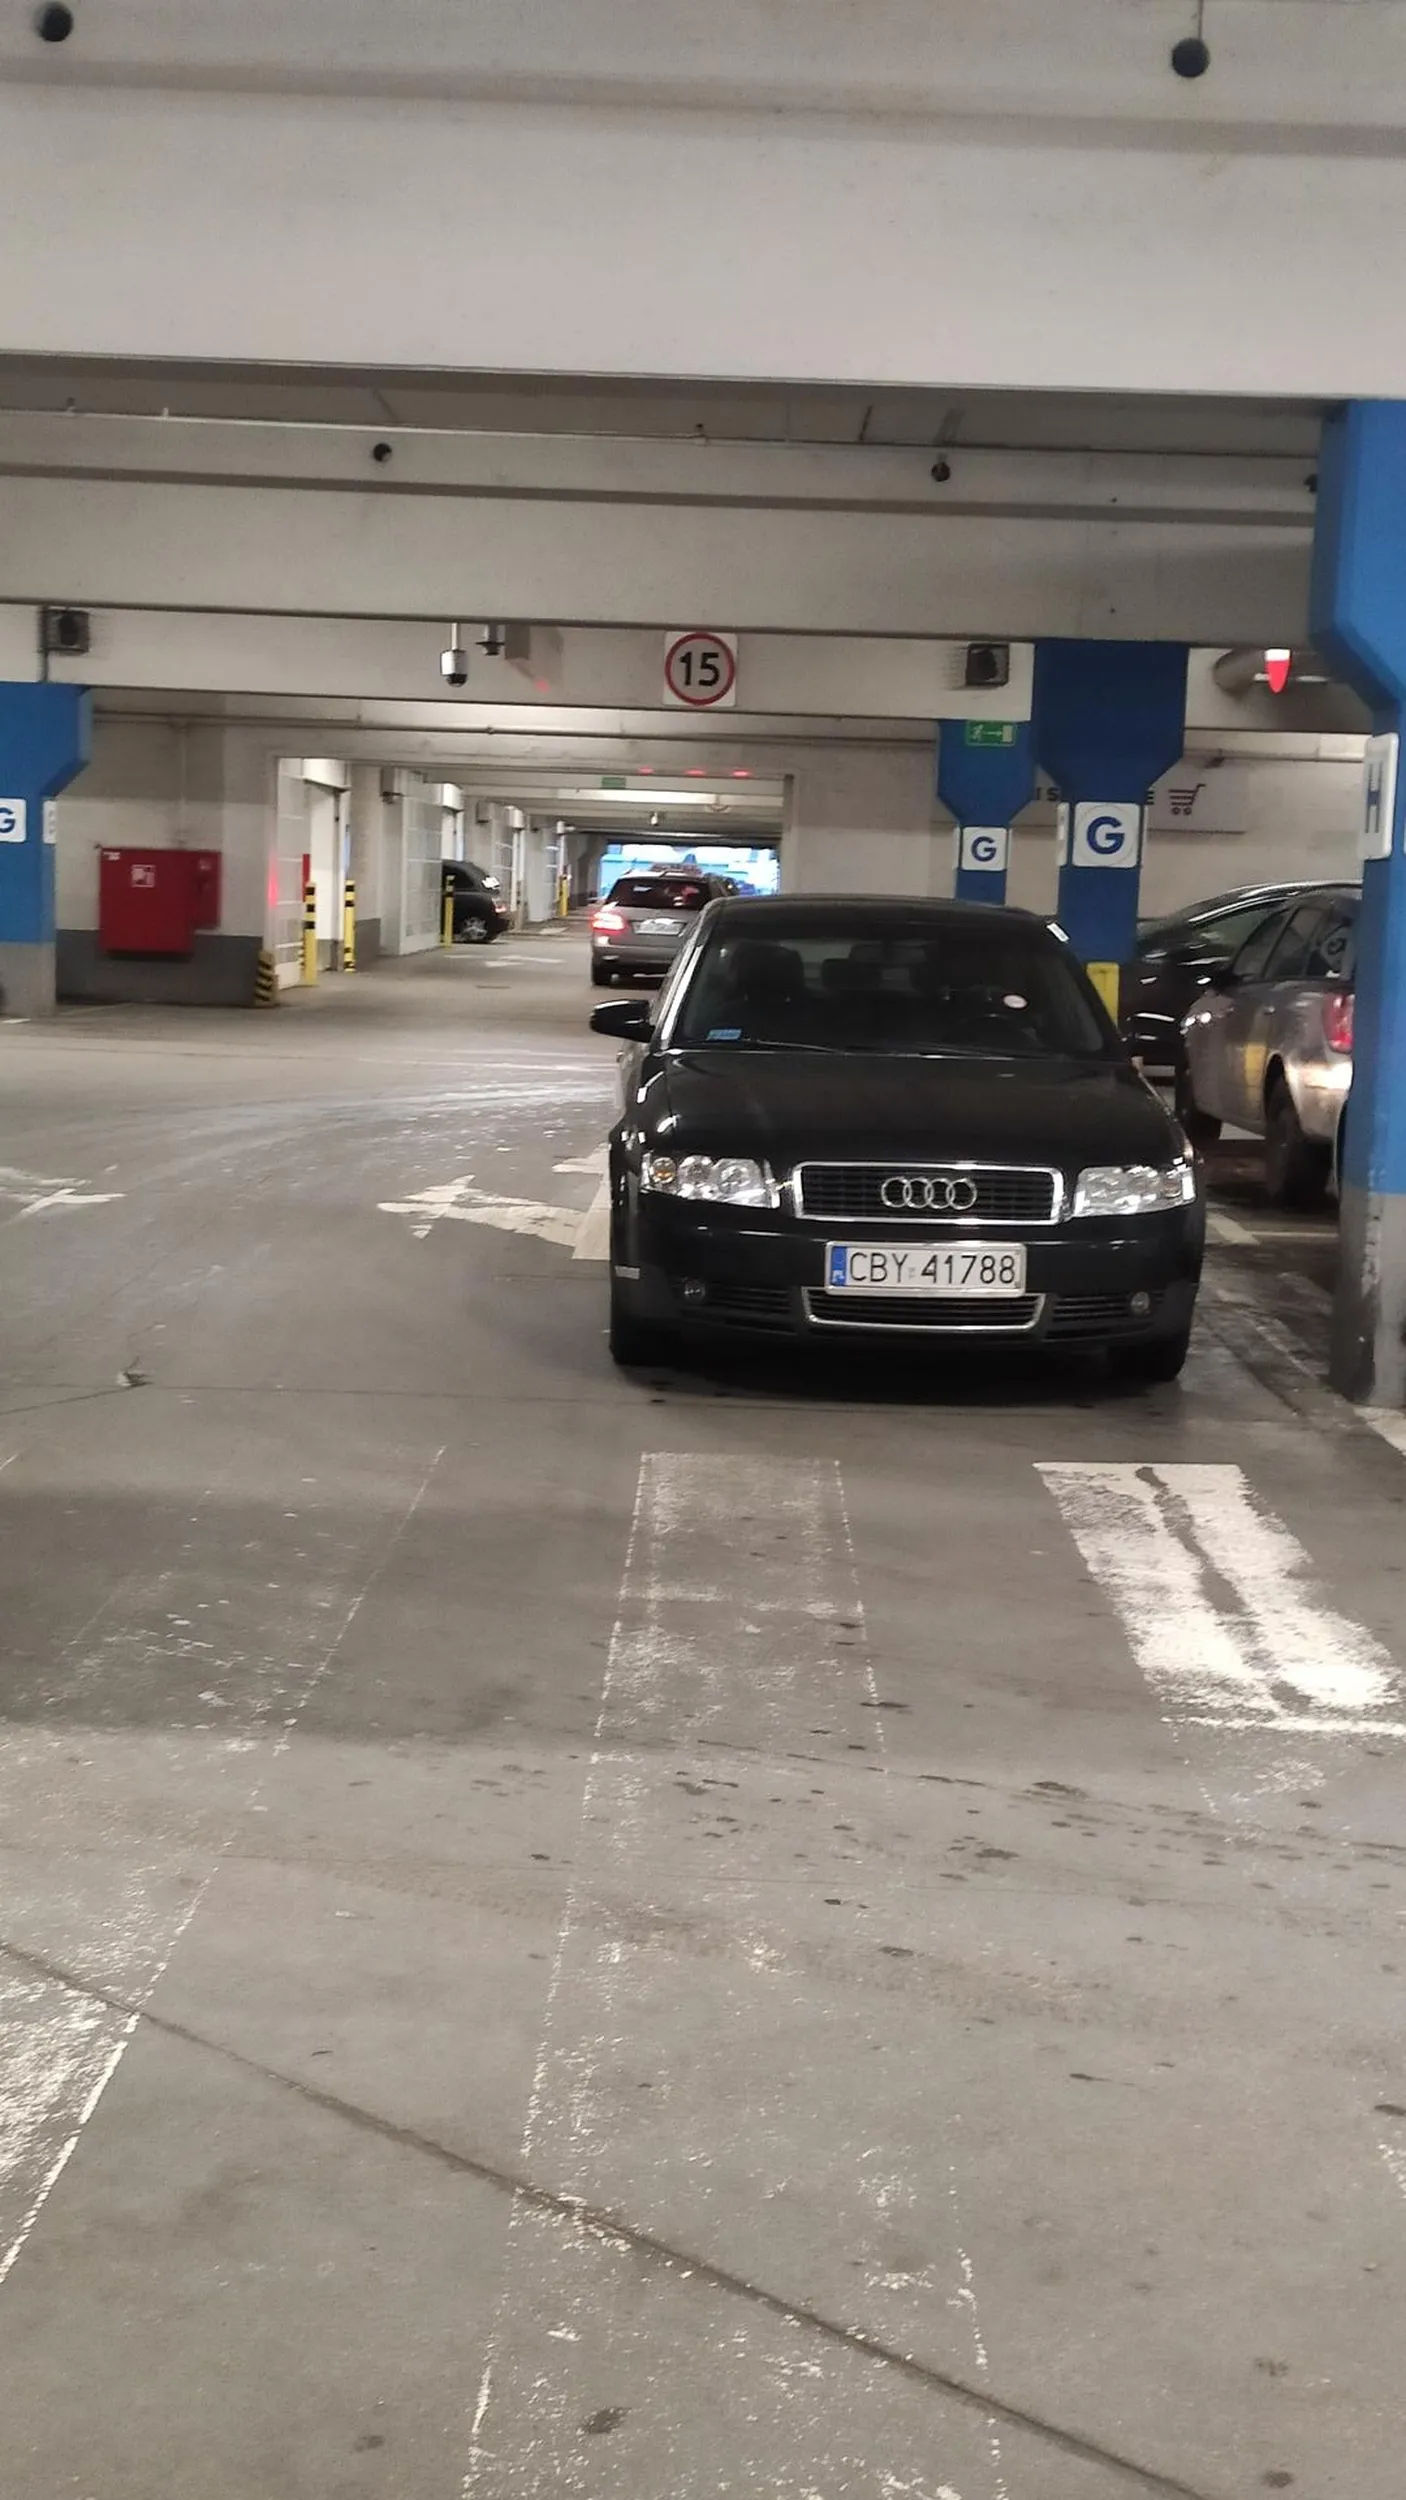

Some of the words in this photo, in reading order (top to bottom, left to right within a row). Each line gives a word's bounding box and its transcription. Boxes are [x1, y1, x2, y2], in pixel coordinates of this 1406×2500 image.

[679, 651, 720, 687] 15
[0, 807, 16, 834] G
[1086, 815, 1125, 855] G
[970, 836, 997, 862] G
[849, 1252, 909, 1284] CBY
[920, 1254, 1016, 1285] 41788
